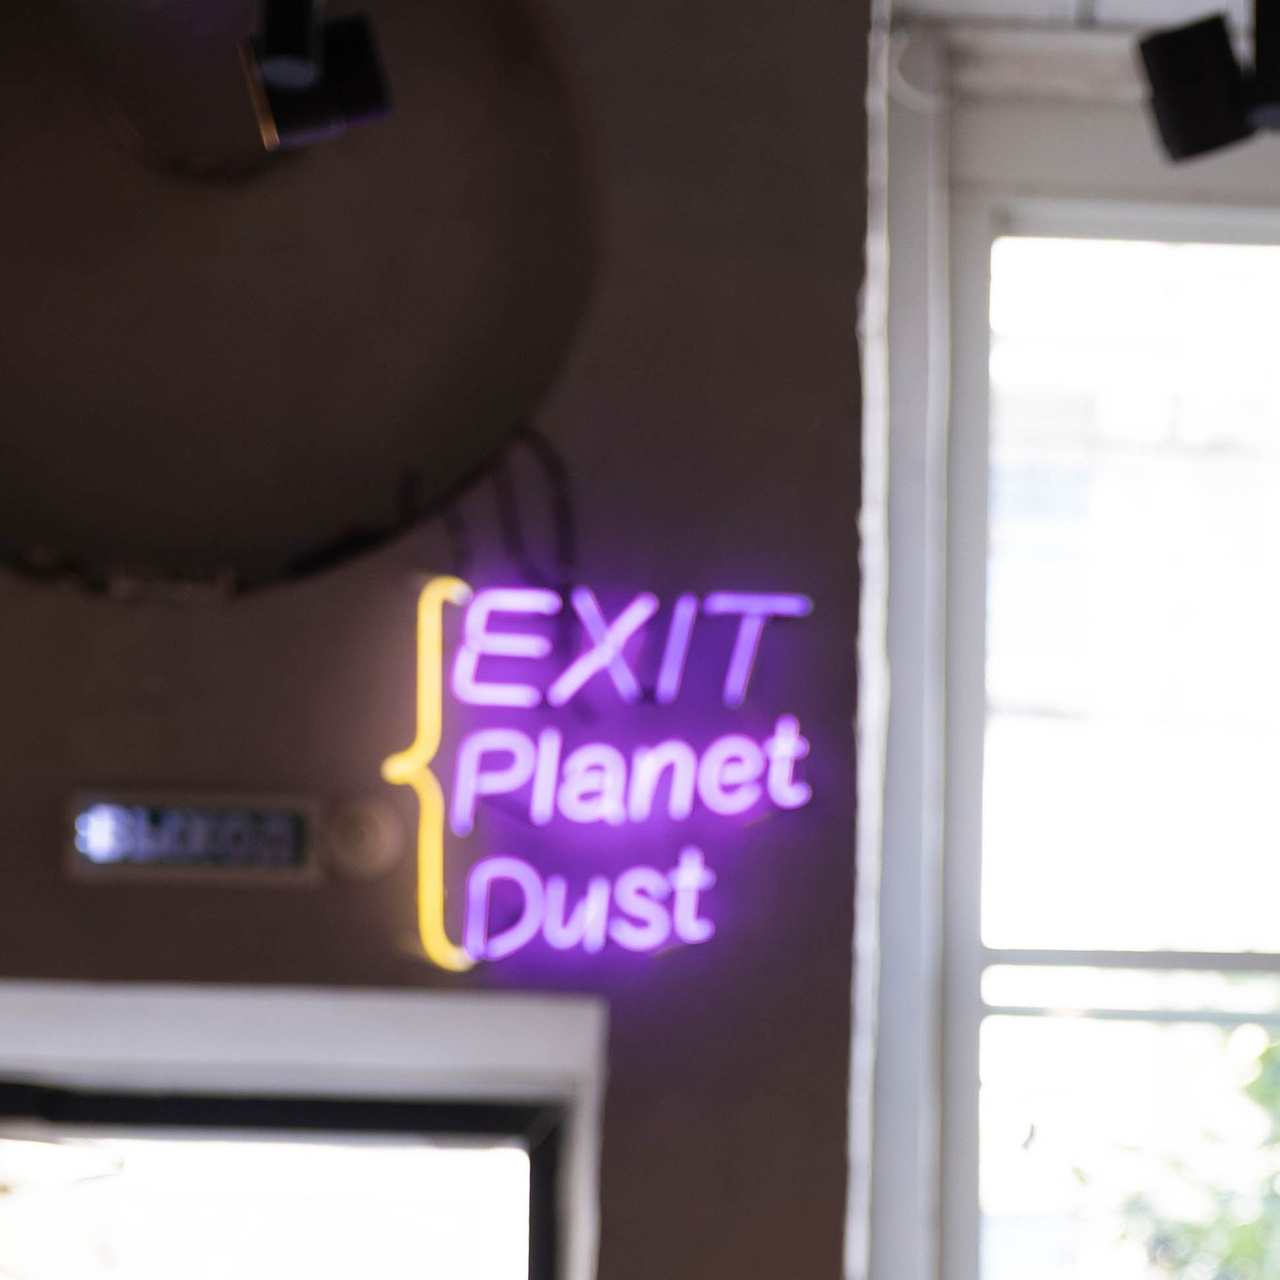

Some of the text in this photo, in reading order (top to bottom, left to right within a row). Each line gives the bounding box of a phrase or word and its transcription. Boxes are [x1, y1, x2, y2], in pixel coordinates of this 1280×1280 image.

[449, 586, 813, 708] EXIT
[449, 713, 812, 837] Planet
[463, 846, 716, 961] Dust
